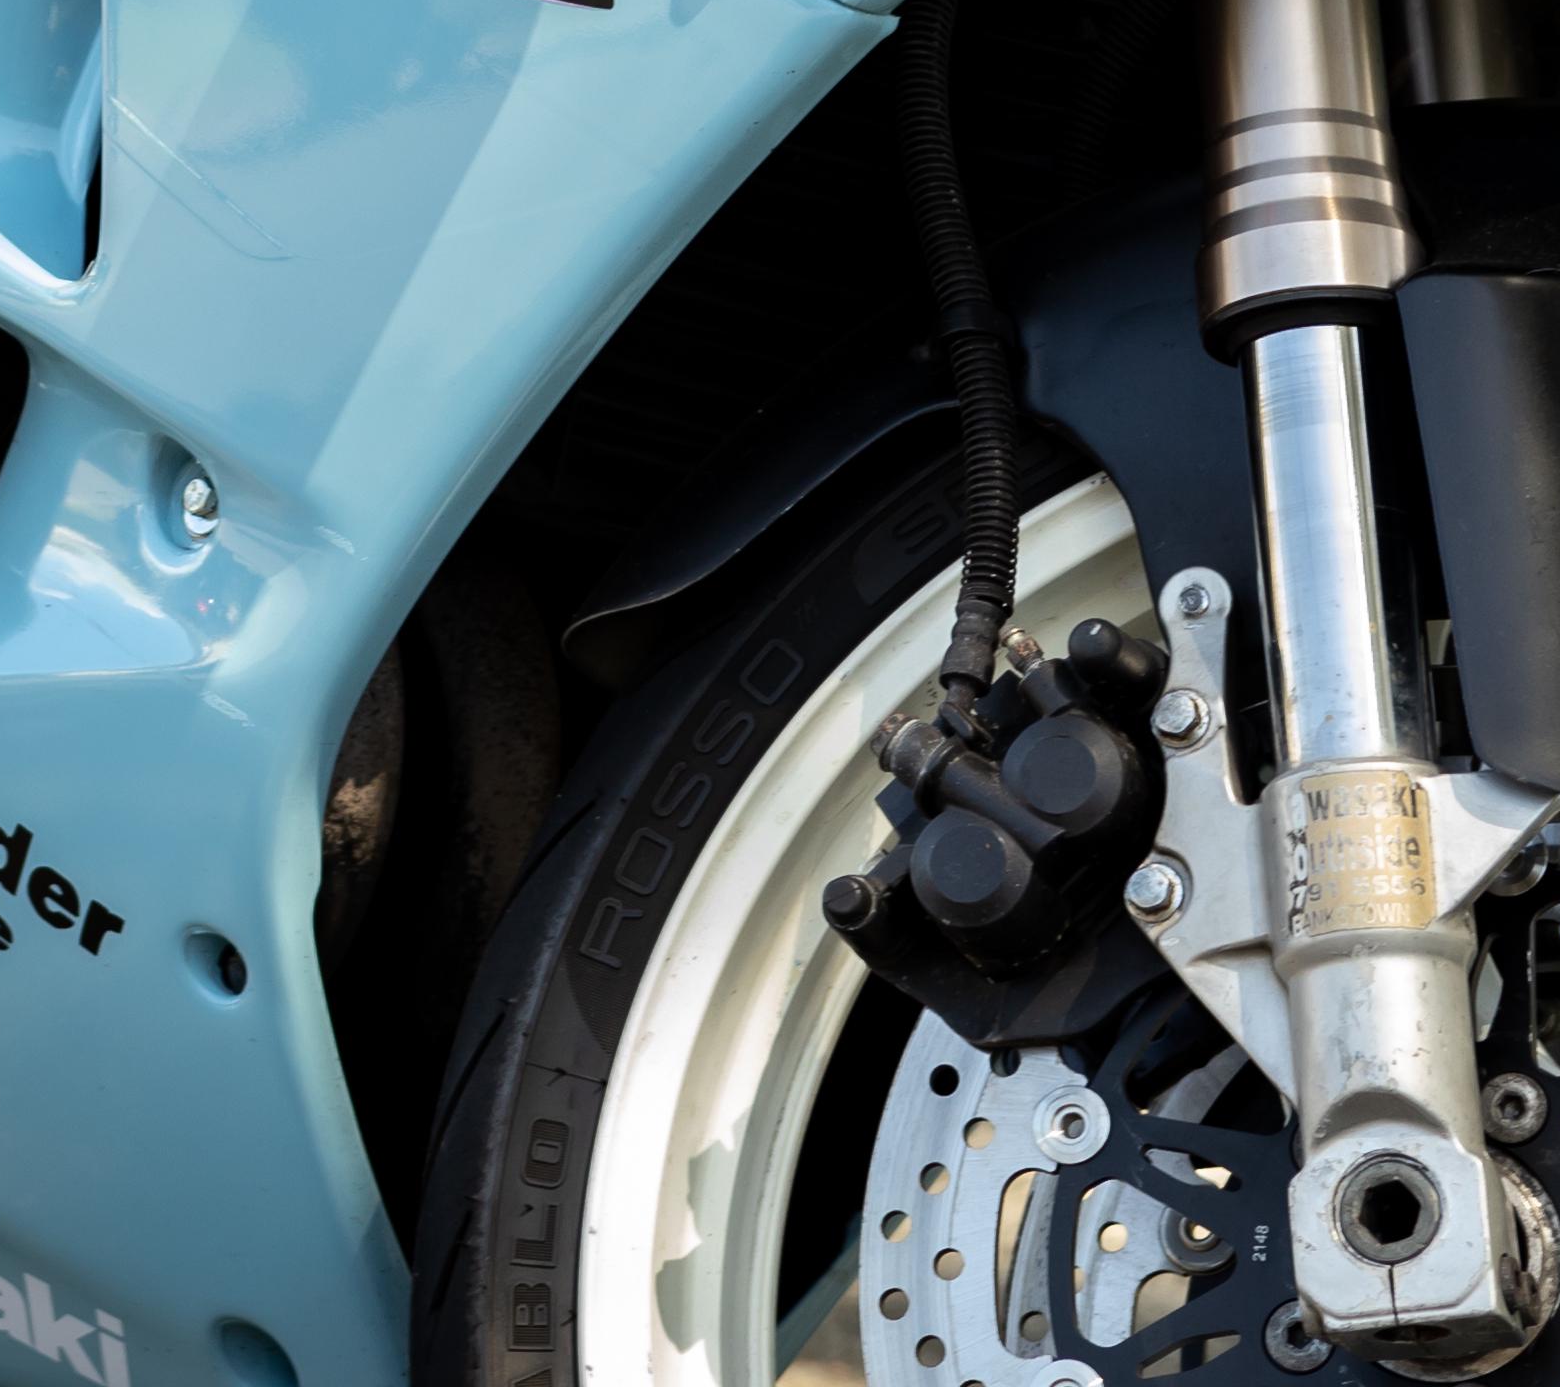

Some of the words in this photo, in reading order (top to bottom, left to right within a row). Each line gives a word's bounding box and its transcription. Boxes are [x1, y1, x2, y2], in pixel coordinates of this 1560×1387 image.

[577, 638, 806, 971] ROSSO
[506, 1117, 570, 1387] BLO
[1251, 1225, 1270, 1262] 2148
